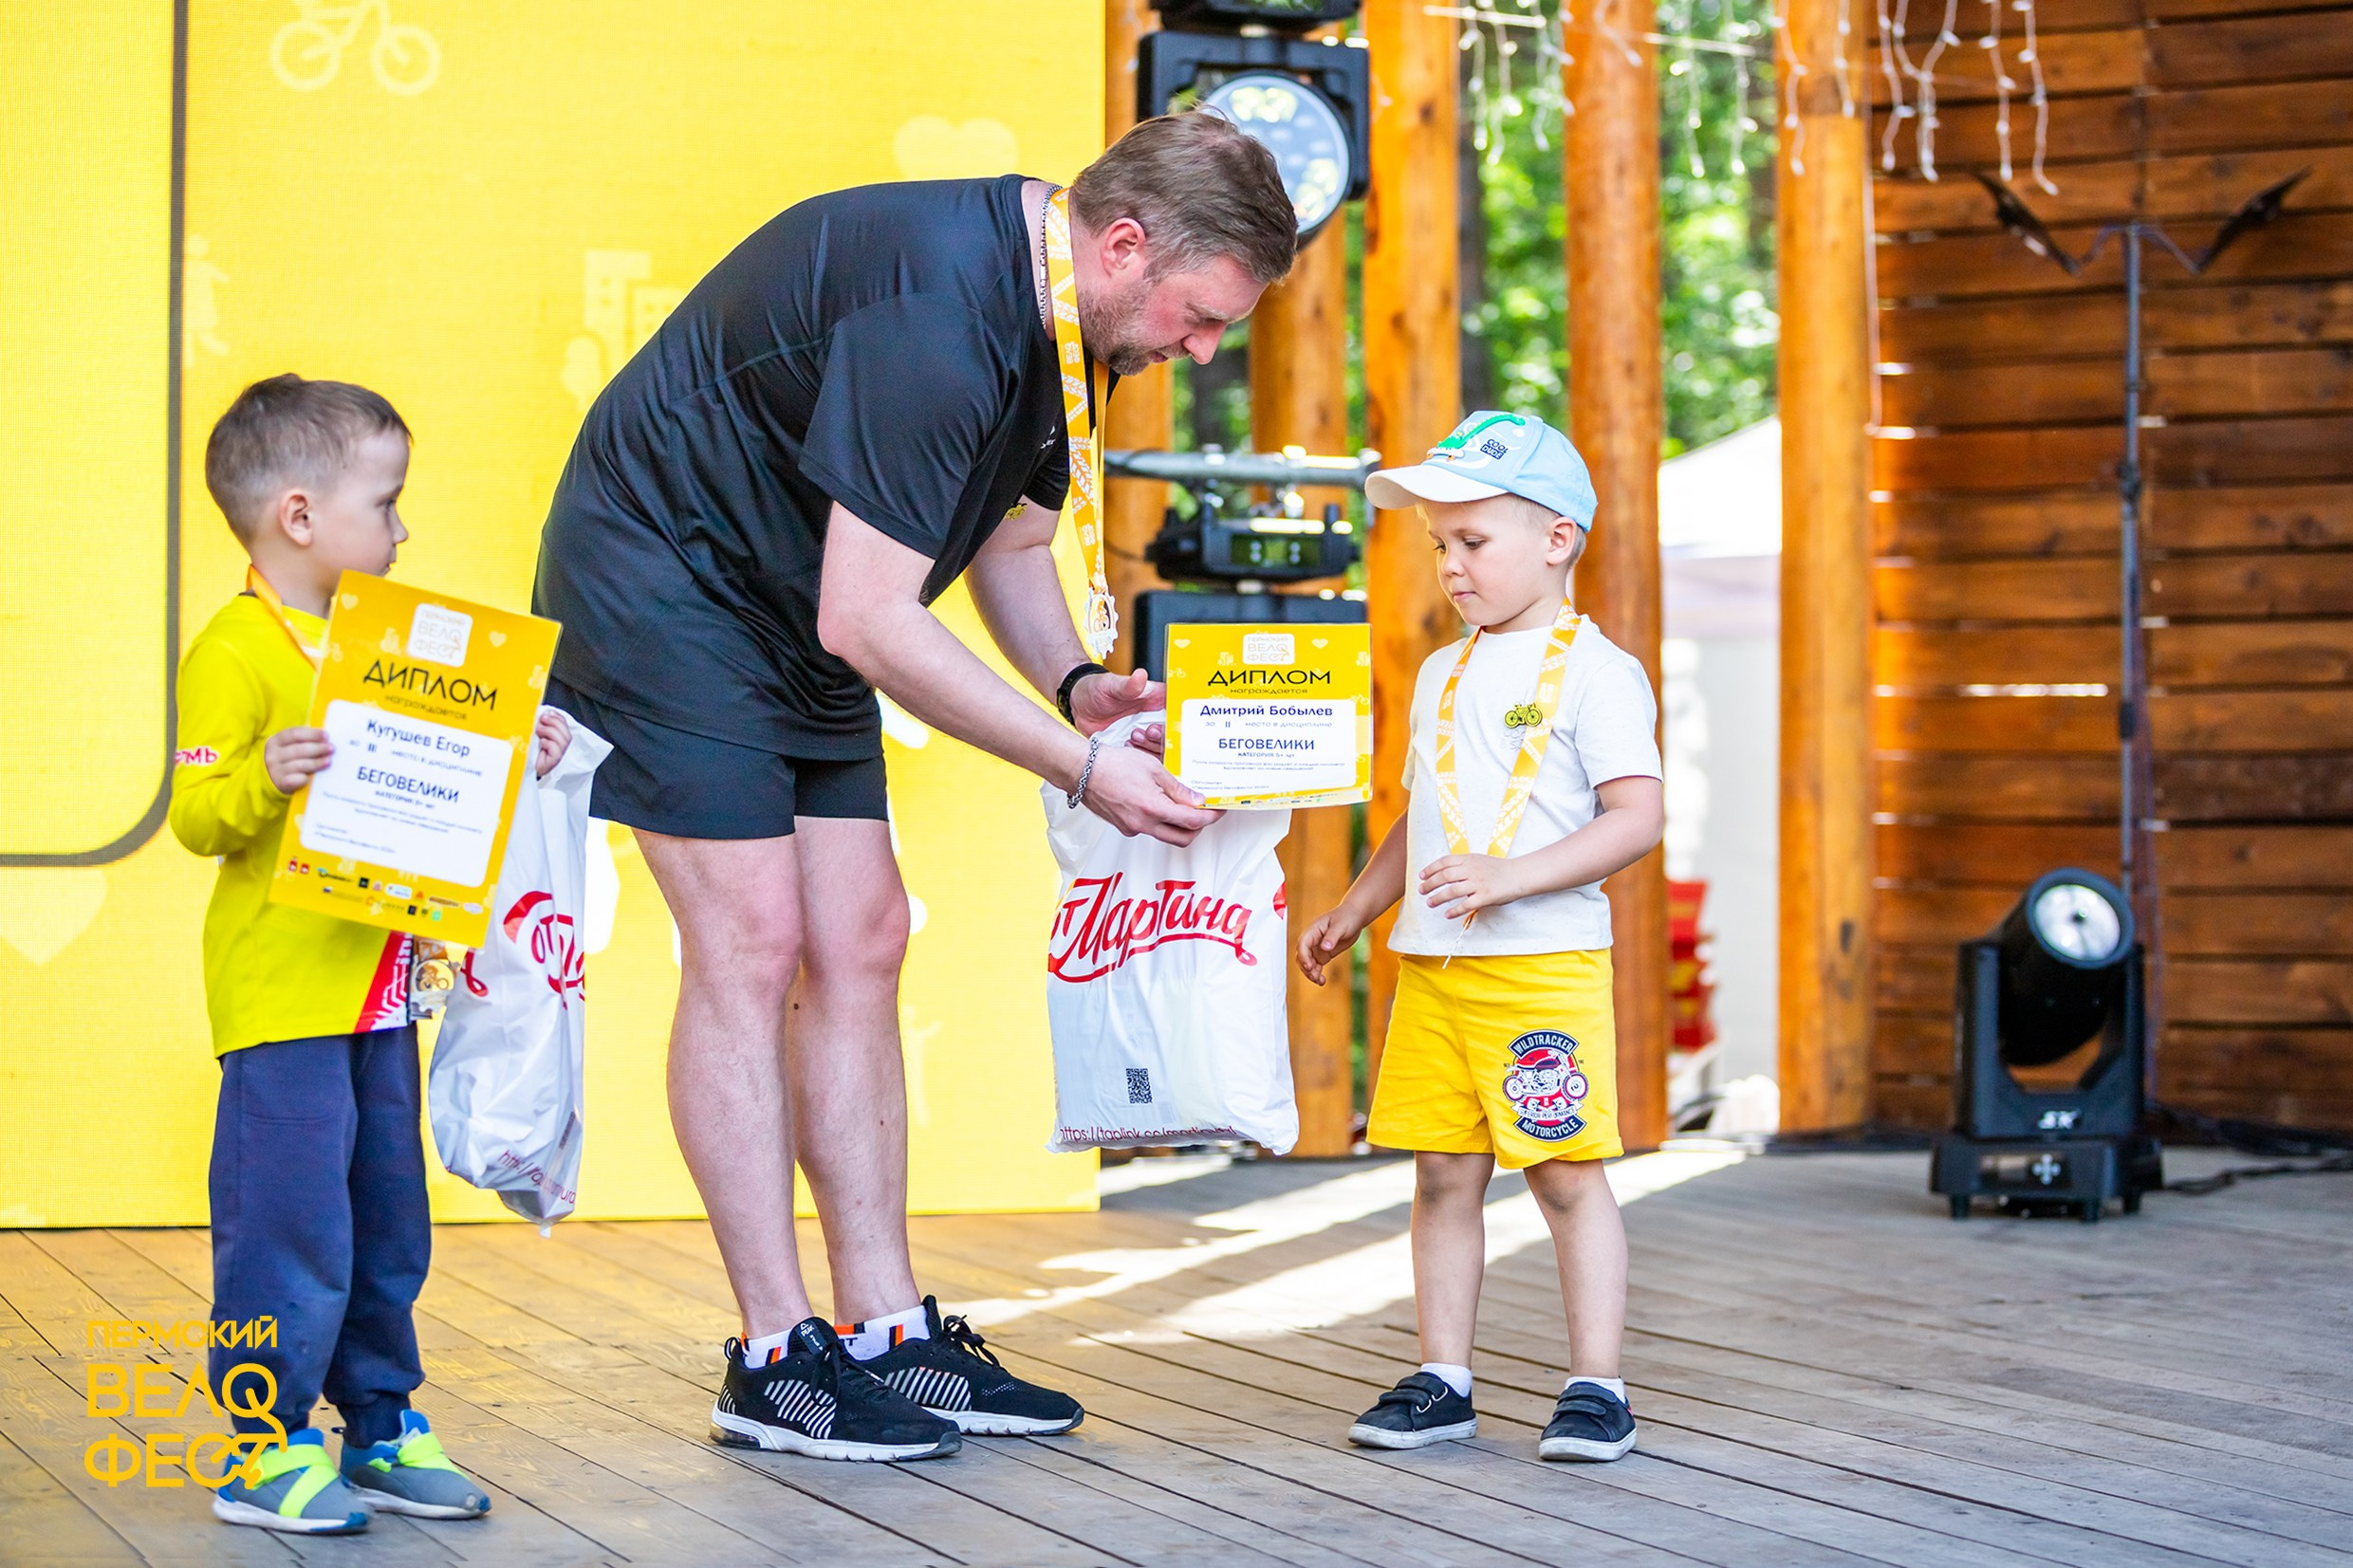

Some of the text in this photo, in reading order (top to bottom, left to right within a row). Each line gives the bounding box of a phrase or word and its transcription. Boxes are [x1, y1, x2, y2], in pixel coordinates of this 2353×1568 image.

[1480, 444, 1504, 460] DUDE
[1487, 438, 1509, 454] COOL
[418, 620, 463, 643] ВЕЛО
[414, 638, 461, 660] ФЕСТ
[1247, 643, 1288, 653] ВЕЛО
[1247, 653, 1288, 662] ФЕСТ
[363, 658, 498, 711] ДИПЛОМ
[1208, 670, 1331, 687] ДИПЛОМ
[1199, 705, 1333, 717] Дмитрий Бобылев
[435, 735, 472, 758] Егор
[1218, 738, 1315, 750] БЕГОВЕЛИКИ
[357, 766, 460, 803] БЕГОВЕЛИКИ
[1512, 1033, 1574, 1055] WILDTRACKER
[1521, 1117, 1579, 1138] MOTORCYCLE
